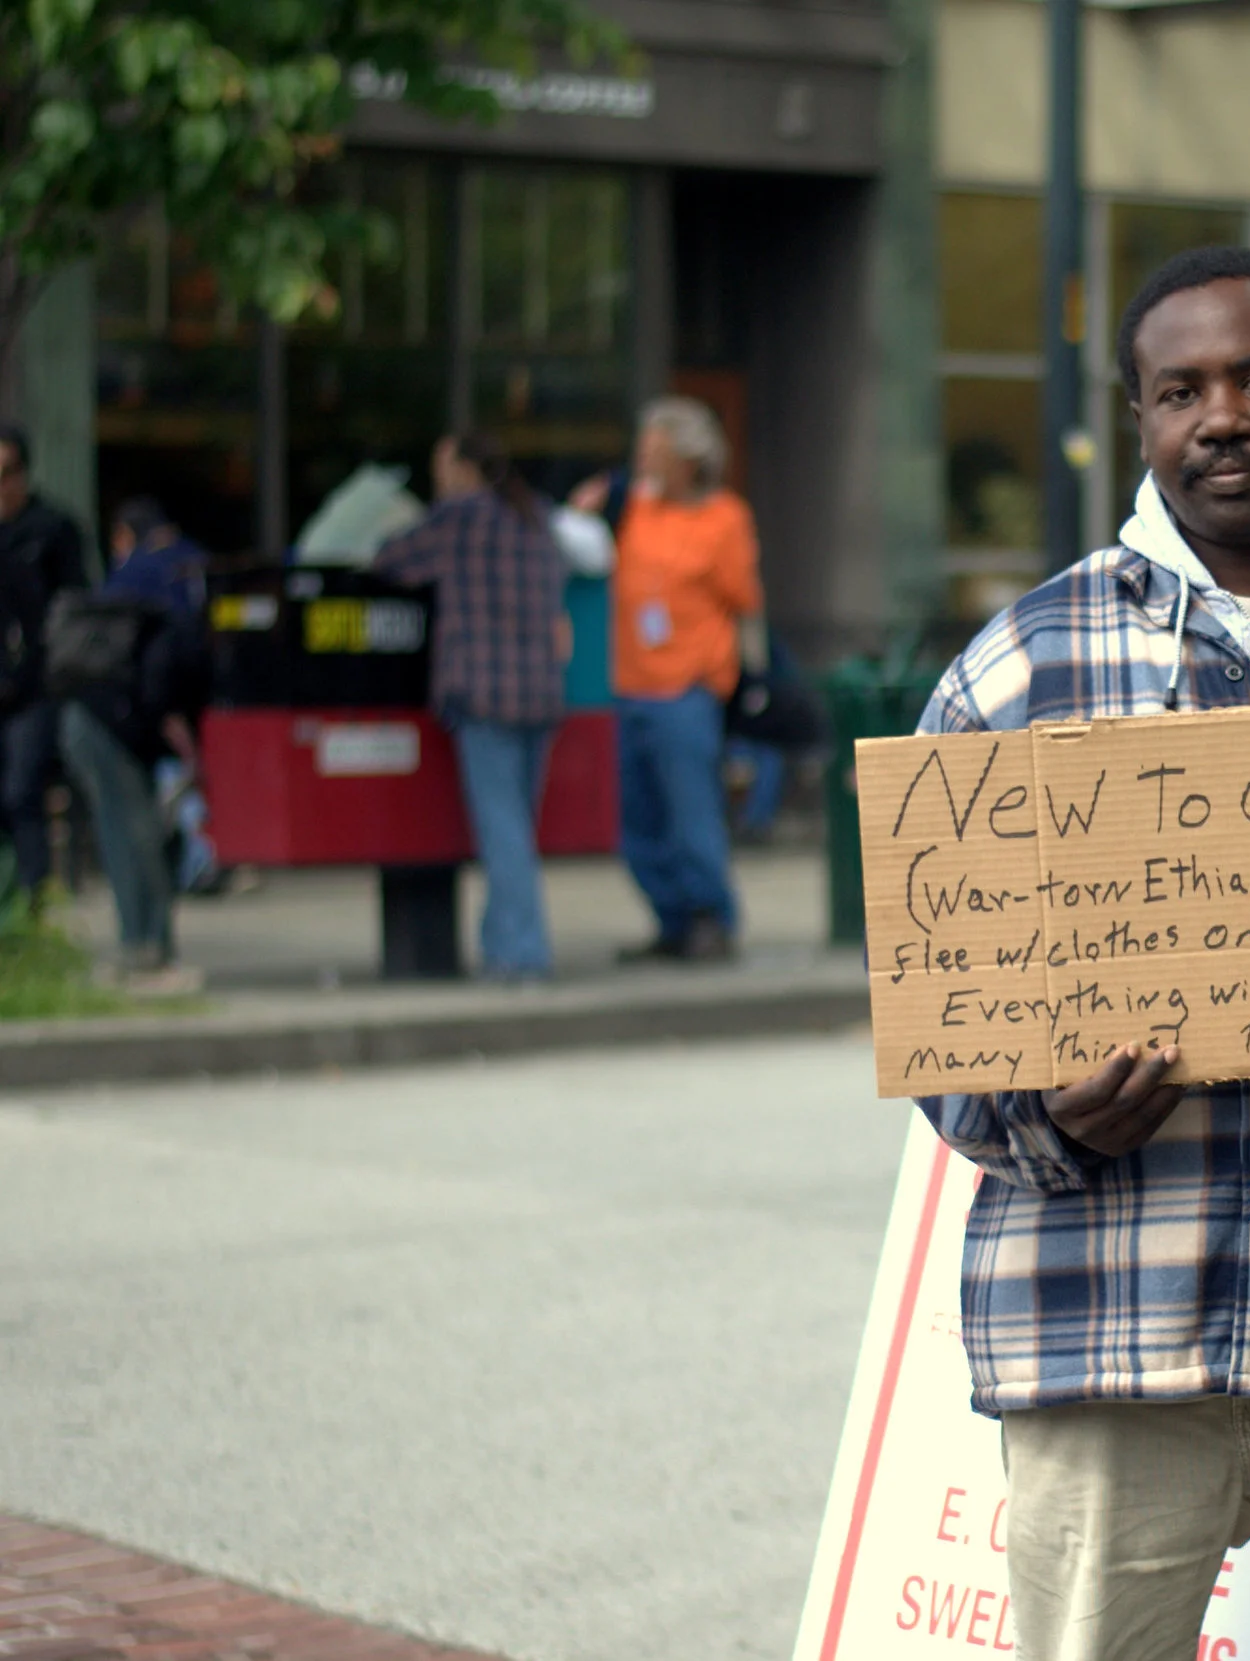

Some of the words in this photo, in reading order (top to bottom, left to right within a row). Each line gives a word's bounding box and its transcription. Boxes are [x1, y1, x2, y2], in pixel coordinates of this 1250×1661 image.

[892, 741, 1106, 841] New
[1138, 763, 1211, 833] To
[942, 980, 1188, 1040] Everything
[936, 1487, 970, 1545] E.
